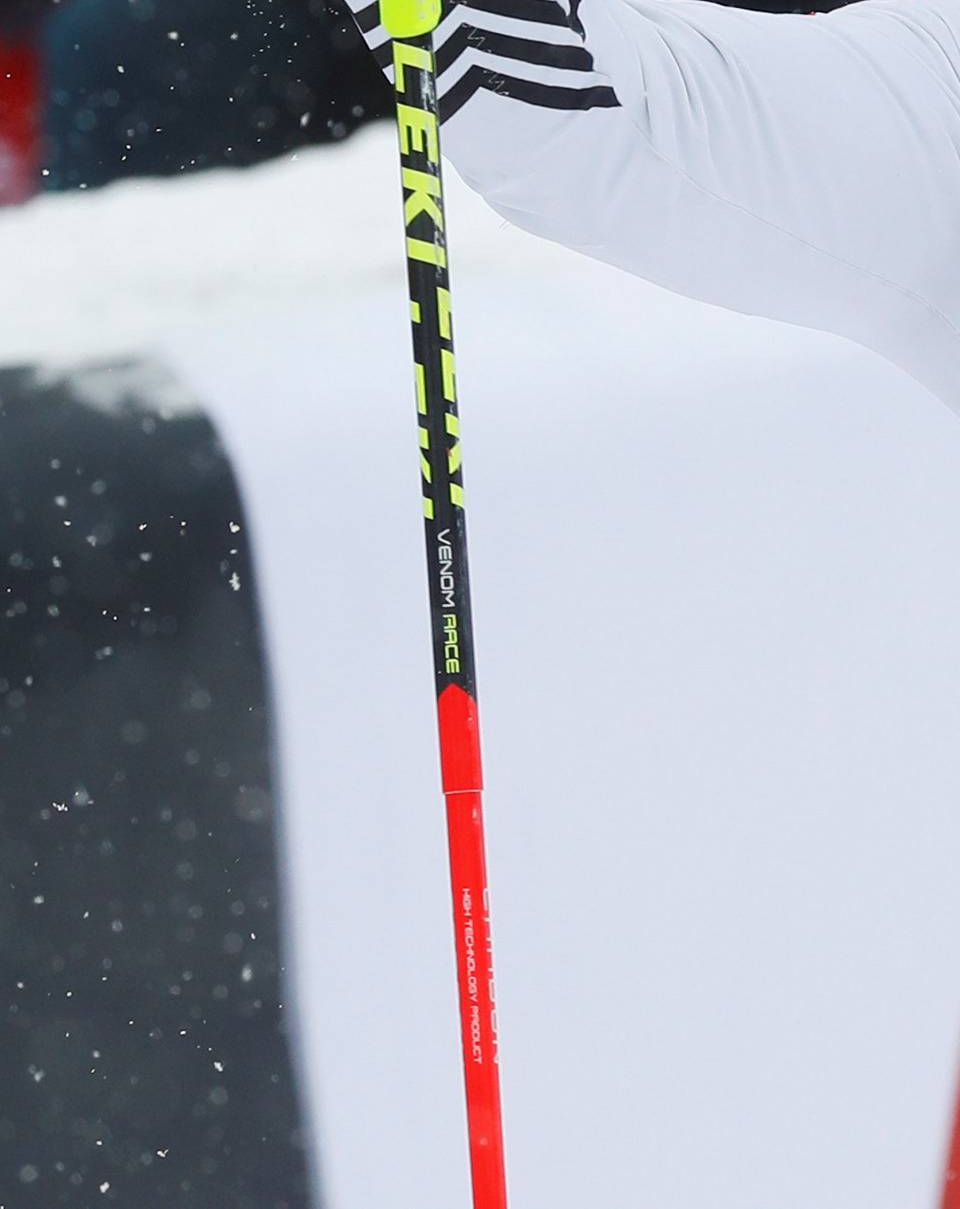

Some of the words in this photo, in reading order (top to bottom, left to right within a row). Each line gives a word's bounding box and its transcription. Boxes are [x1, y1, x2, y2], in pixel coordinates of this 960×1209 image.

[392, 41, 448, 269] LEKI
[437, 528, 456, 608] VENOM
[442, 613, 461, 674] RACE
